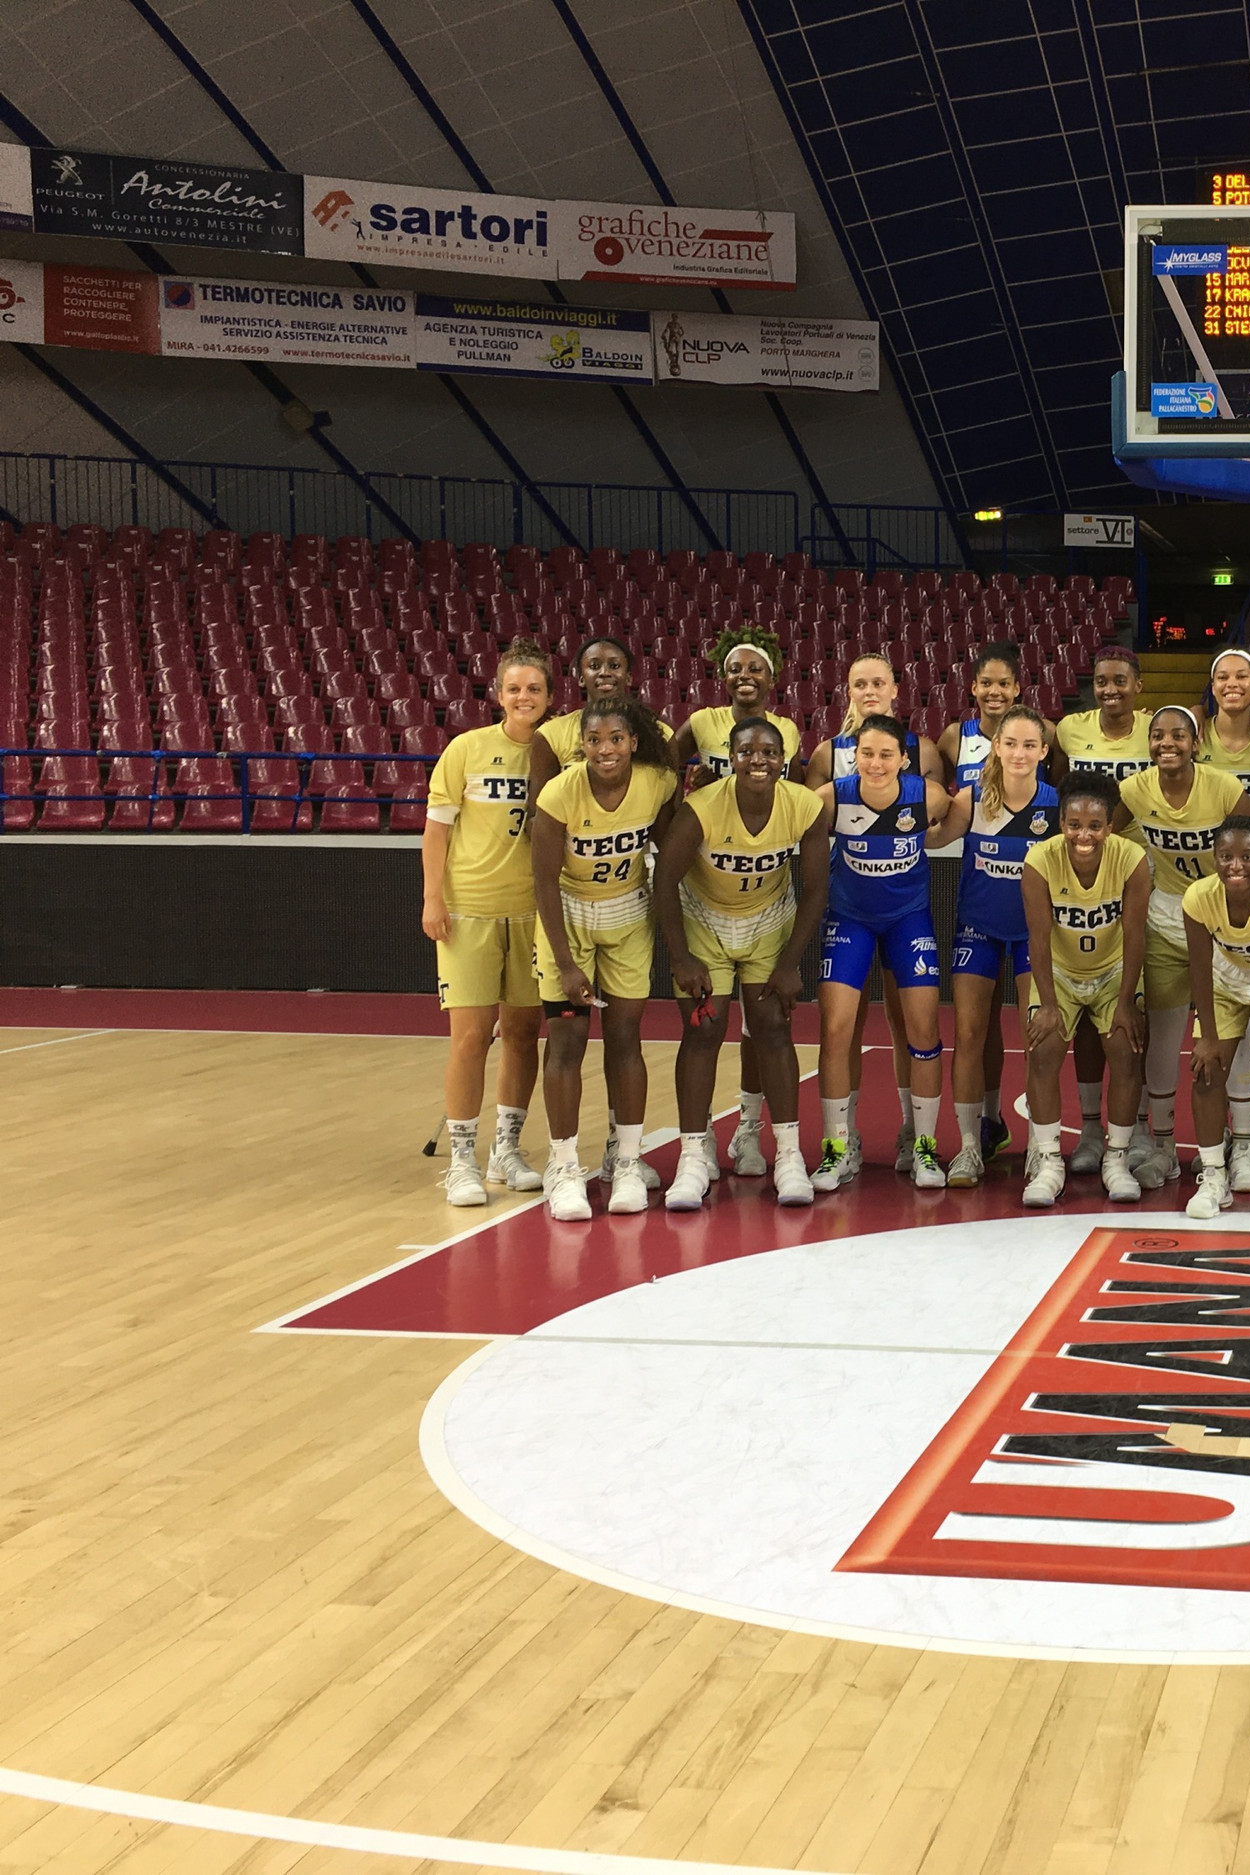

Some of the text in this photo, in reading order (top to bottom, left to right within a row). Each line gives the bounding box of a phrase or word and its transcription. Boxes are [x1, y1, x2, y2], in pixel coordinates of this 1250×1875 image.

[154, 163, 250, 181] CONCESSIONARIA
[120, 170, 288, 210] Antolini
[1212, 174, 1222, 189] 3
[36, 187, 106, 200] PEUGEOT
[1212, 190, 1222, 204] 5
[148, 198, 267, 220] Commerciale
[40, 204, 63, 215] Via
[111, 210, 168, 225] Goretti
[174, 216, 199, 228] 8/3
[206, 219, 263, 234] MESTRE
[271, 225, 301, 238] (VE)
[369, 202, 548, 248] sartori
[577, 209, 697, 242] grafiche
[92, 222, 248, 244] www.autovenezia.it
[370, 232, 548, 258] IMPRESA EDILE
[623, 235, 769, 262] veneziane
[1171, 252, 1222, 263] MYGLASS
[672, 263, 769, 277] Industria Grafica Editoriale
[1206, 272, 1221, 286] 15
[63, 275, 143, 291] SACCHETTI PER
[63, 286, 137, 301] RACCOGLIERE
[198, 283, 407, 313] TERMOTECNICA SAVIO
[1206, 288, 1221, 302] 17
[63, 309, 133, 322] PROTEGGERE
[452, 301, 617, 327] www.baldoinviaggi.it
[1204, 304, 1221, 318] 22
[199, 315, 409, 336] IMPIANTISTICA ENERGIE ALTERNATIVE
[423, 322, 543, 341] AGENZIA TURISTICA
[760, 319, 833, 333] Nuova Compagnia
[1204, 320, 1219, 335] 31
[222, 327, 388, 346] SERVIZIO ASSISTENZA TECNICA
[448, 336, 519, 350] E NOLEGGIO
[760, 329, 877, 342] Lavoratori Portuali di Venezia
[166, 340, 270, 355] MIRA 041.4266599
[282, 348, 411, 363] www.termotecnicasavio.it
[456, 349, 511, 362] PULLMAN
[581, 346, 643, 363] BALDOIN
[682, 338, 750, 355] NUOVA
[760, 347, 841, 359] PORTO MARGHERA
[582, 358, 642, 370] VIAGGI
[682, 351, 722, 365] CLP
[761, 366, 854, 382] www.nuovaclp.it
[1066, 518, 1131, 545] settore VI
[571, 826, 651, 857] TECH
[893, 837, 919, 857] 31
[1142, 829, 1217, 852] TECH
[710, 843, 794, 874] TECH
[850, 853, 919, 874] CINKARNA
[590, 859, 630, 886] 24
[1173, 856, 1206, 881] 41
[737, 875, 763, 893] 11
[1051, 900, 1122, 929] TECH
[1079, 935, 1097, 953] 0
